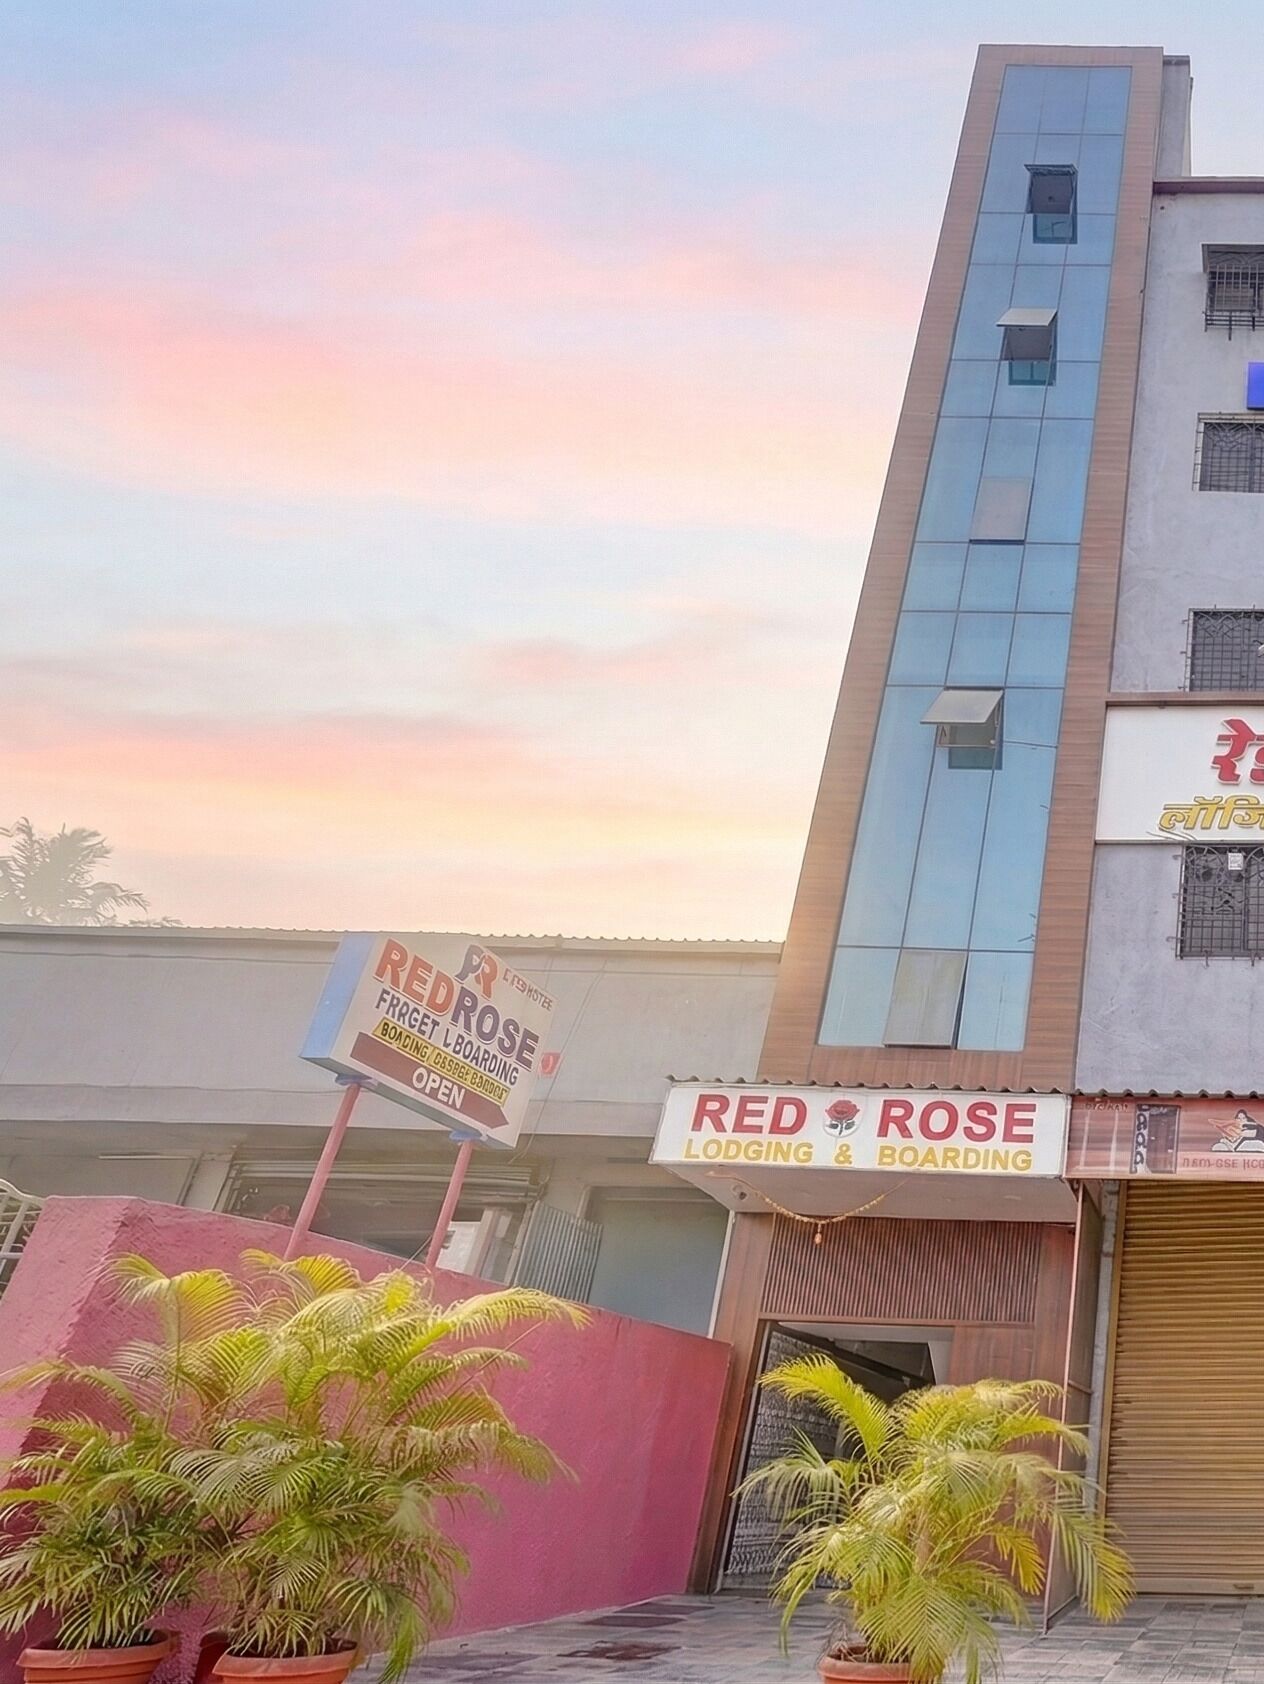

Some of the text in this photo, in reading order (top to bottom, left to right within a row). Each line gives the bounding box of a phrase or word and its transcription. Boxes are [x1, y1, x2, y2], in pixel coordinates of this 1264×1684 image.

[373, 938, 455, 1016] RED
[450, 986, 539, 1070] ROSE
[412, 1067, 466, 1109] OPEN
[691, 1094, 1037, 1144] RED ROSE
[684, 1138, 1032, 1171] LODGING & BOARDING
